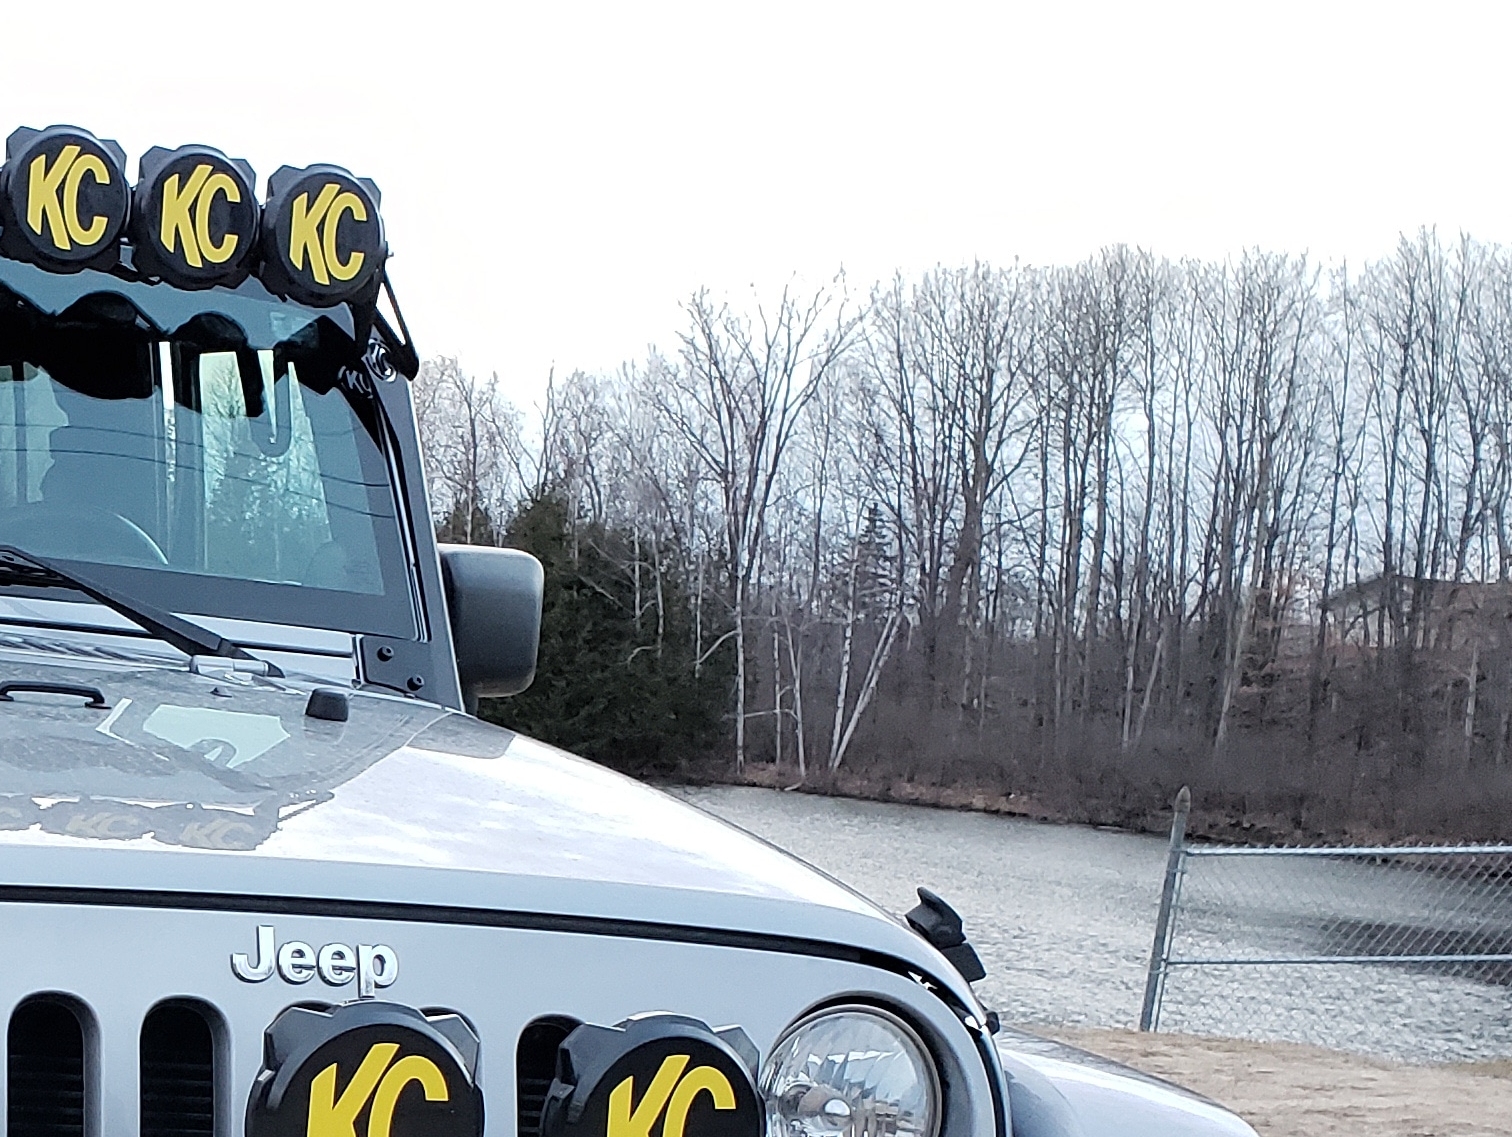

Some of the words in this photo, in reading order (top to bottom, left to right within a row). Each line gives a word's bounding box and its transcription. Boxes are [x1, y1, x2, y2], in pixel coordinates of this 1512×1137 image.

[27, 145, 110, 250] KC
[161, 164, 241, 268] KC
[289, 184, 367, 285] KC
[230, 924, 400, 998] Jeep
